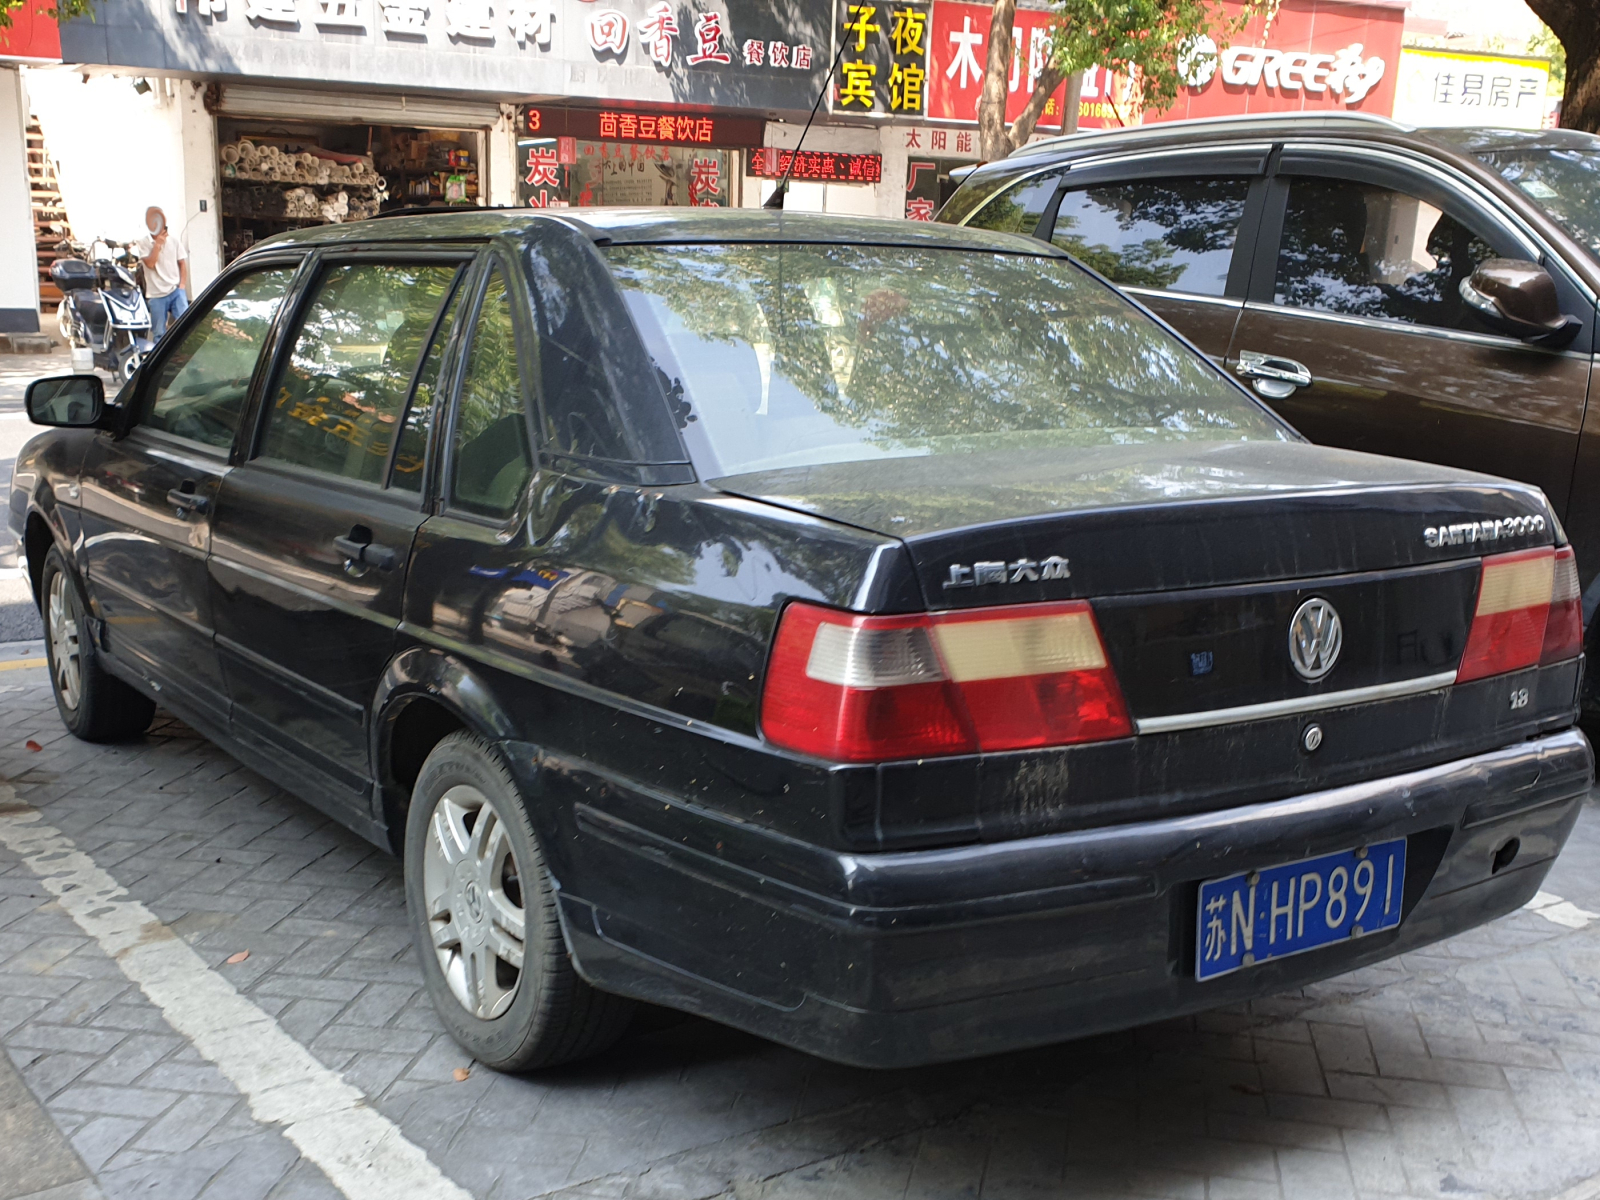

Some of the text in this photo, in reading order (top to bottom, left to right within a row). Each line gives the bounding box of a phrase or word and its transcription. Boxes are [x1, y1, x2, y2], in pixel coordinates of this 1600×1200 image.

[843, 5, 927, 56] 子夜
[742, 39, 813, 70] 餐饮店
[1221, 46, 1336, 92] GREE
[840, 59, 925, 110] 宾馆
[1433, 71, 1539, 108] 佳易房产
[528, 109, 714, 142] 3 茴香豆餐饮店
[905, 128, 972, 153] 太阳能
